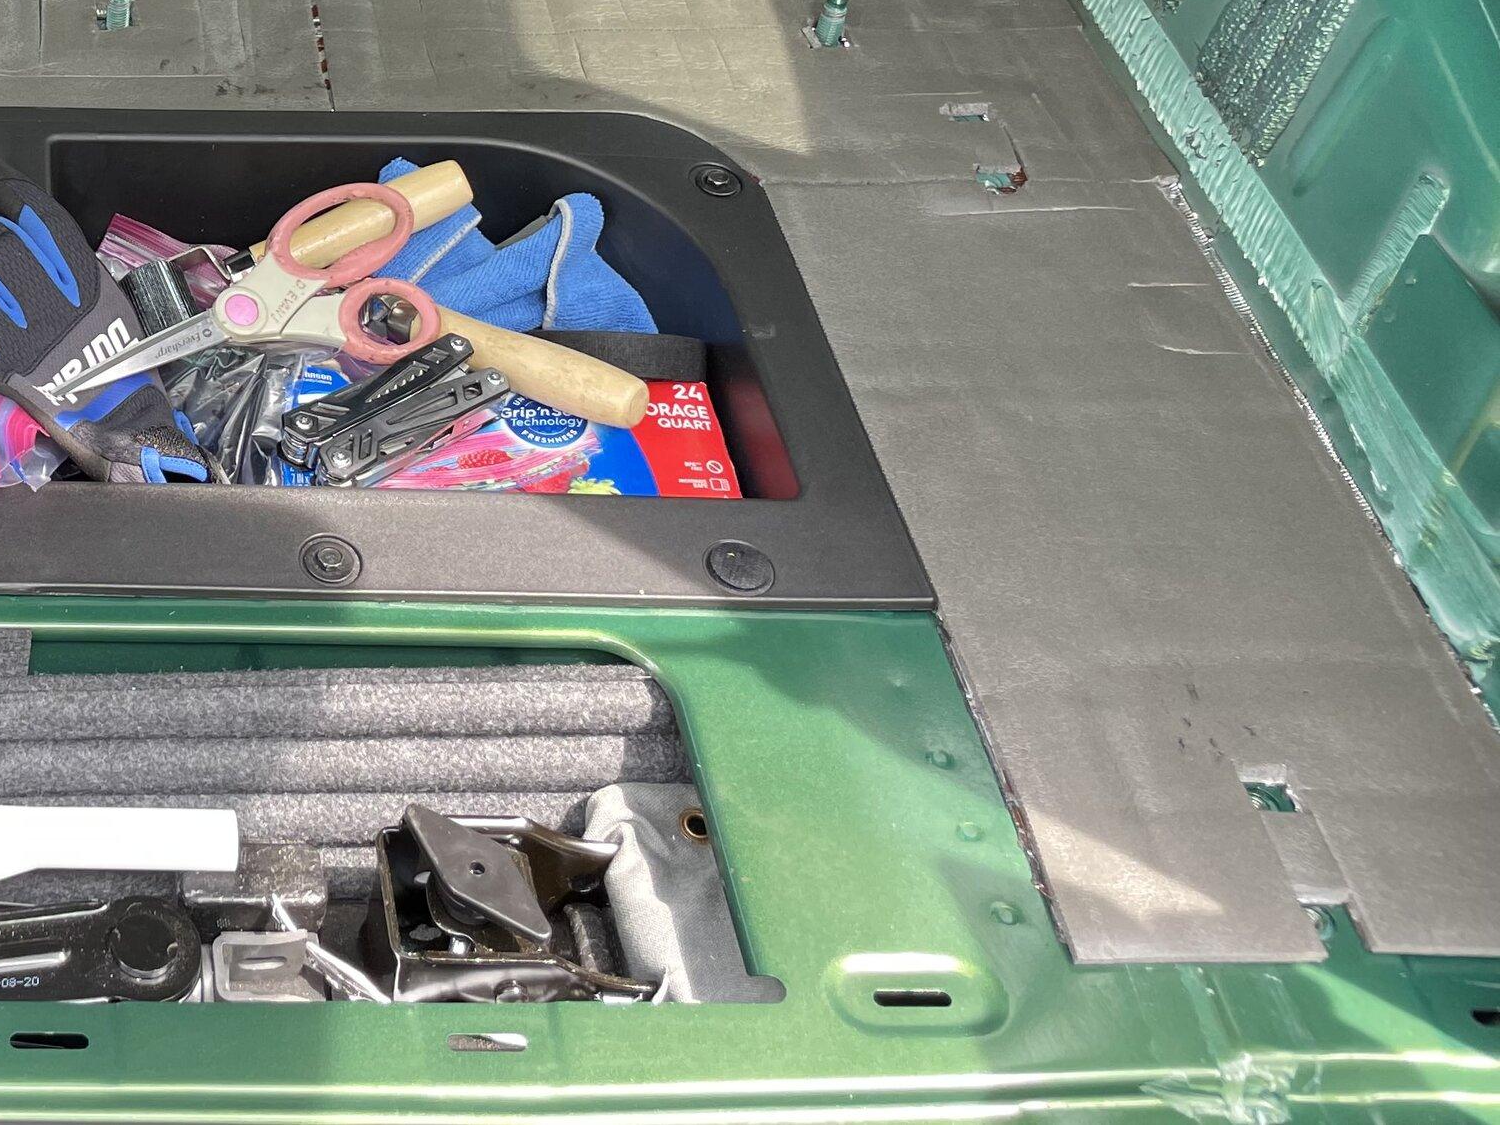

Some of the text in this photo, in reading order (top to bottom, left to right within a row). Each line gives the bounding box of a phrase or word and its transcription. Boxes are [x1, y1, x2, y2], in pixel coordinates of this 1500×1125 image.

[672, 384, 703, 402] 24
[646, 402, 711, 420] ORAGE
[510, 418, 583, 428] Technology
[657, 417, 712, 431] QUART
[520, 429, 578, 444] FRESHNESS
